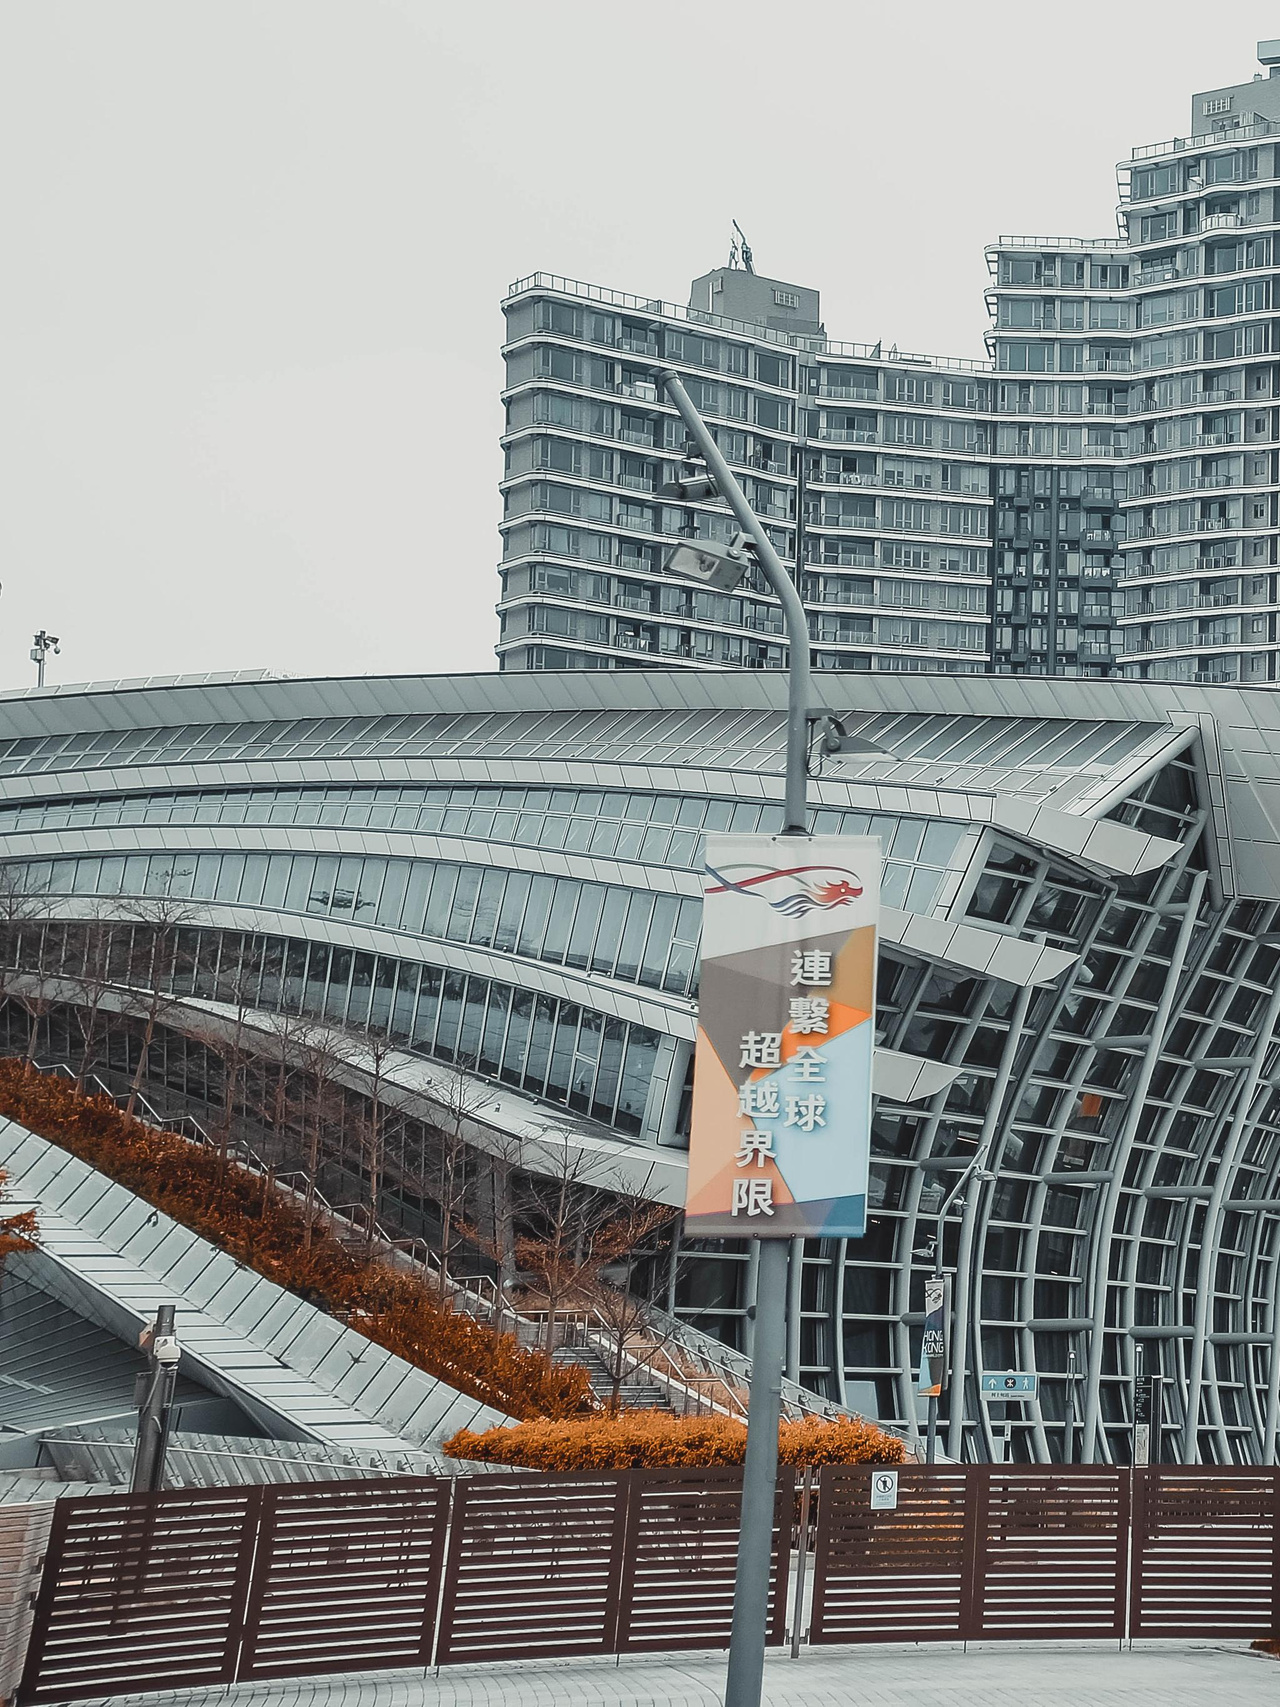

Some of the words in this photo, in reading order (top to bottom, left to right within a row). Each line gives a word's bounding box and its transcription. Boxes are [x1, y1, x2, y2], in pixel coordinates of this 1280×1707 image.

[783, 949, 833, 1132] 連繫全球
[731, 1030, 783, 1217] 超越界限
[922, 1342, 944, 1353] KONG
[923, 1330, 943, 1341] HONG
